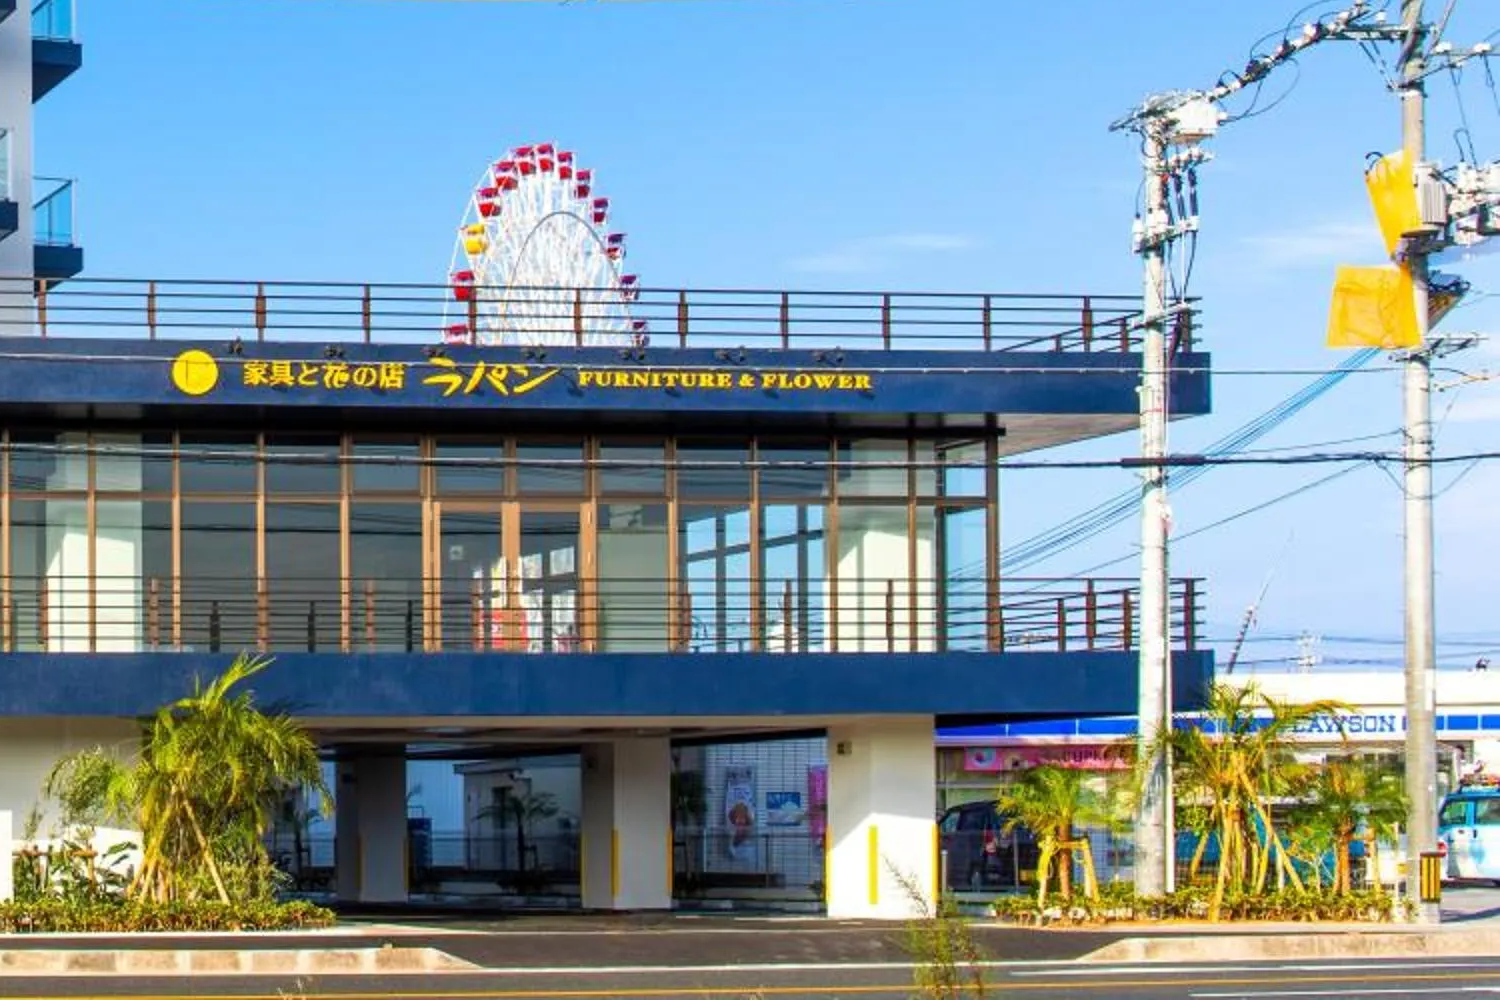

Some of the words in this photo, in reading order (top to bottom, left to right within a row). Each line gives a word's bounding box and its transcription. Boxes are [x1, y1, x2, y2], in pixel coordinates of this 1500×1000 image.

[243, 360, 405, 390] 家具と花の店
[422, 356, 562, 397] ラパン
[578, 371, 732, 388] FURNITURE
[739, 373, 755, 388] &
[763, 372, 873, 390] FLOWER
